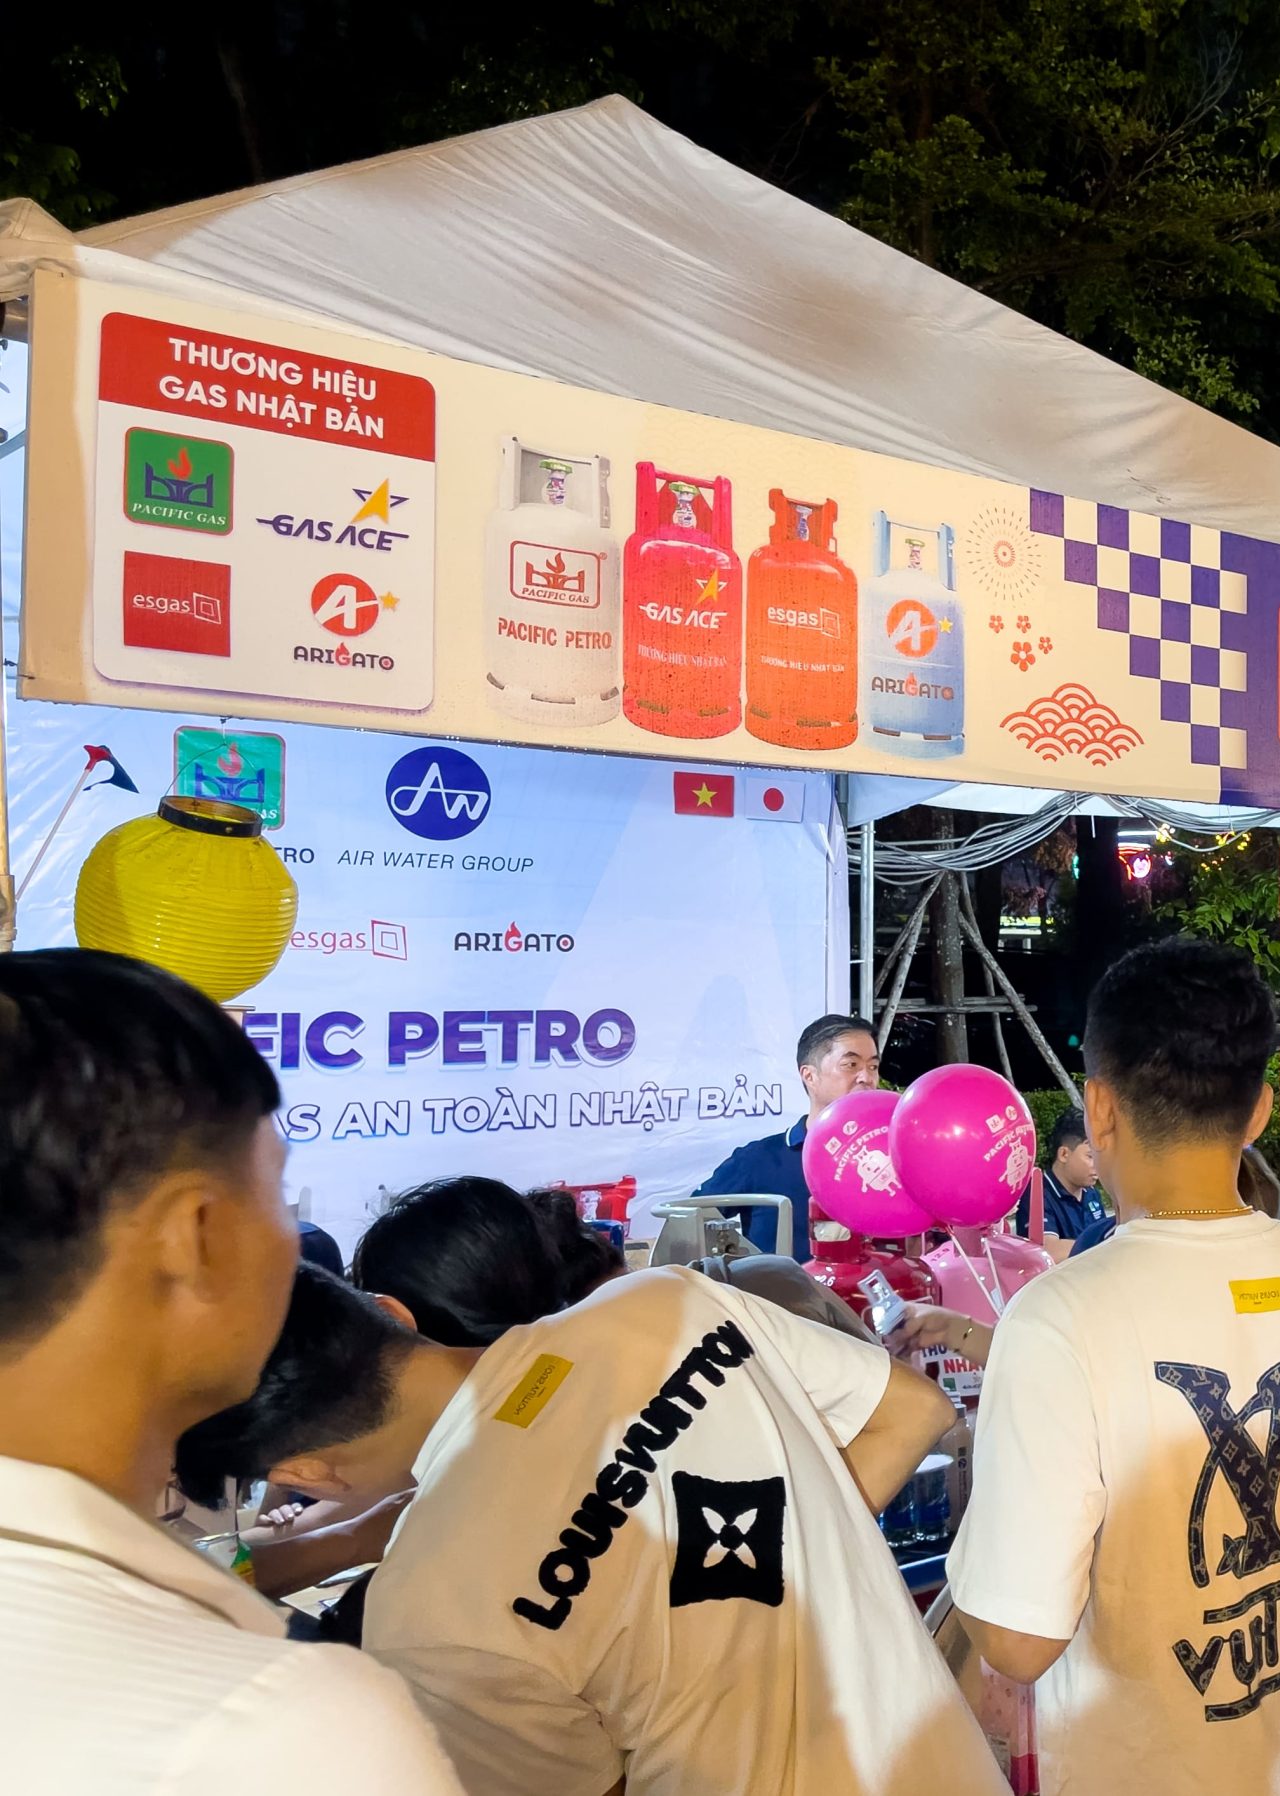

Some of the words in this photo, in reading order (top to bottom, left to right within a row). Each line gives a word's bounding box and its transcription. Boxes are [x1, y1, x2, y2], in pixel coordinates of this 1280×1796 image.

[169, 337, 302, 385] THƯƠNG
[313, 368, 376, 402] HIỆU
[159, 375, 228, 409] GAS
[237, 389, 317, 428] NHẬT
[325, 405, 384, 440] BẢN
[132, 502, 194, 521] PACIFIC
[197, 512, 227, 527] GAS
[256, 514, 333, 542] GAS
[335, 526, 409, 551] ACE
[133, 593, 191, 613] esgas
[521, 587, 566, 603] PACIFIC
[568, 593, 590, 605] GAS
[638, 602, 682, 626] GAS
[684, 608, 727, 629] ACE
[768, 606, 819, 628] esgas
[498, 617, 557, 647] PACIFIC
[565, 630, 612, 650] PETRO
[293, 642, 395, 671] ARIGATO
[872, 672, 954, 701] ARIGATO
[337, 848, 375, 867] AIR
[383, 851, 454, 870] WATER
[461, 854, 534, 874] GROUP
[290, 929, 367, 954] esgas
[454, 921, 575, 953] ARIGATO
[388, 1008, 636, 1068] PETRO
[333, 1100, 410, 1140] AN
[423, 1086, 556, 1133] TOÀN
[570, 1081, 689, 1132] NHẬT
[697, 1074, 782, 1120] BẢN
[834, 1143, 858, 1180] PACIFIC
[856, 1126, 889, 1146] PETRO
